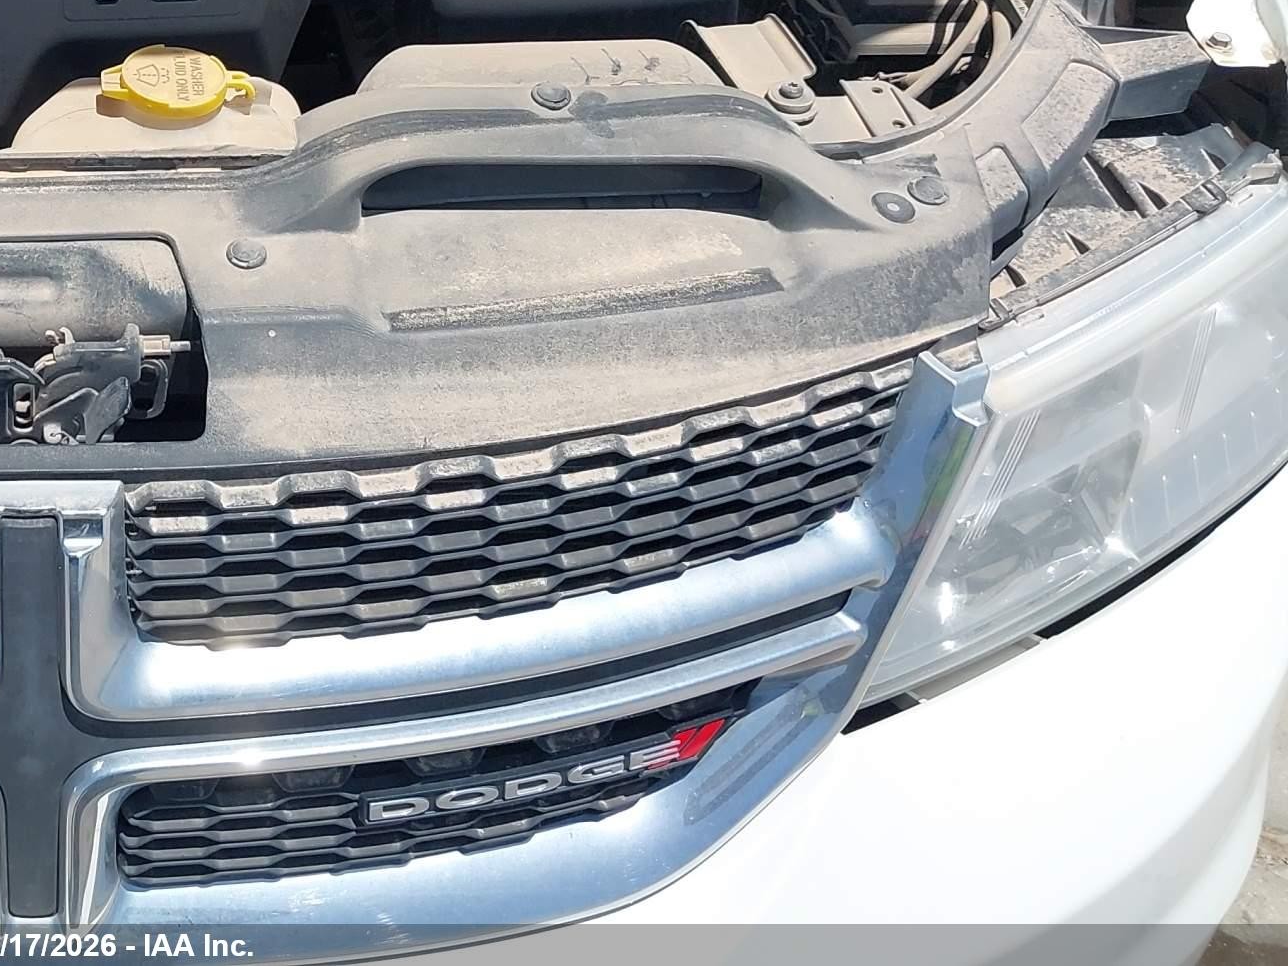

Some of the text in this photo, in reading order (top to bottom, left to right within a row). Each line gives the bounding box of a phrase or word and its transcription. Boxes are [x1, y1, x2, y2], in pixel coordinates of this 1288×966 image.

[176, 78, 190, 101] ONLY
[190, 56, 205, 96] WASHER
[368, 739, 681, 822] DODGE
